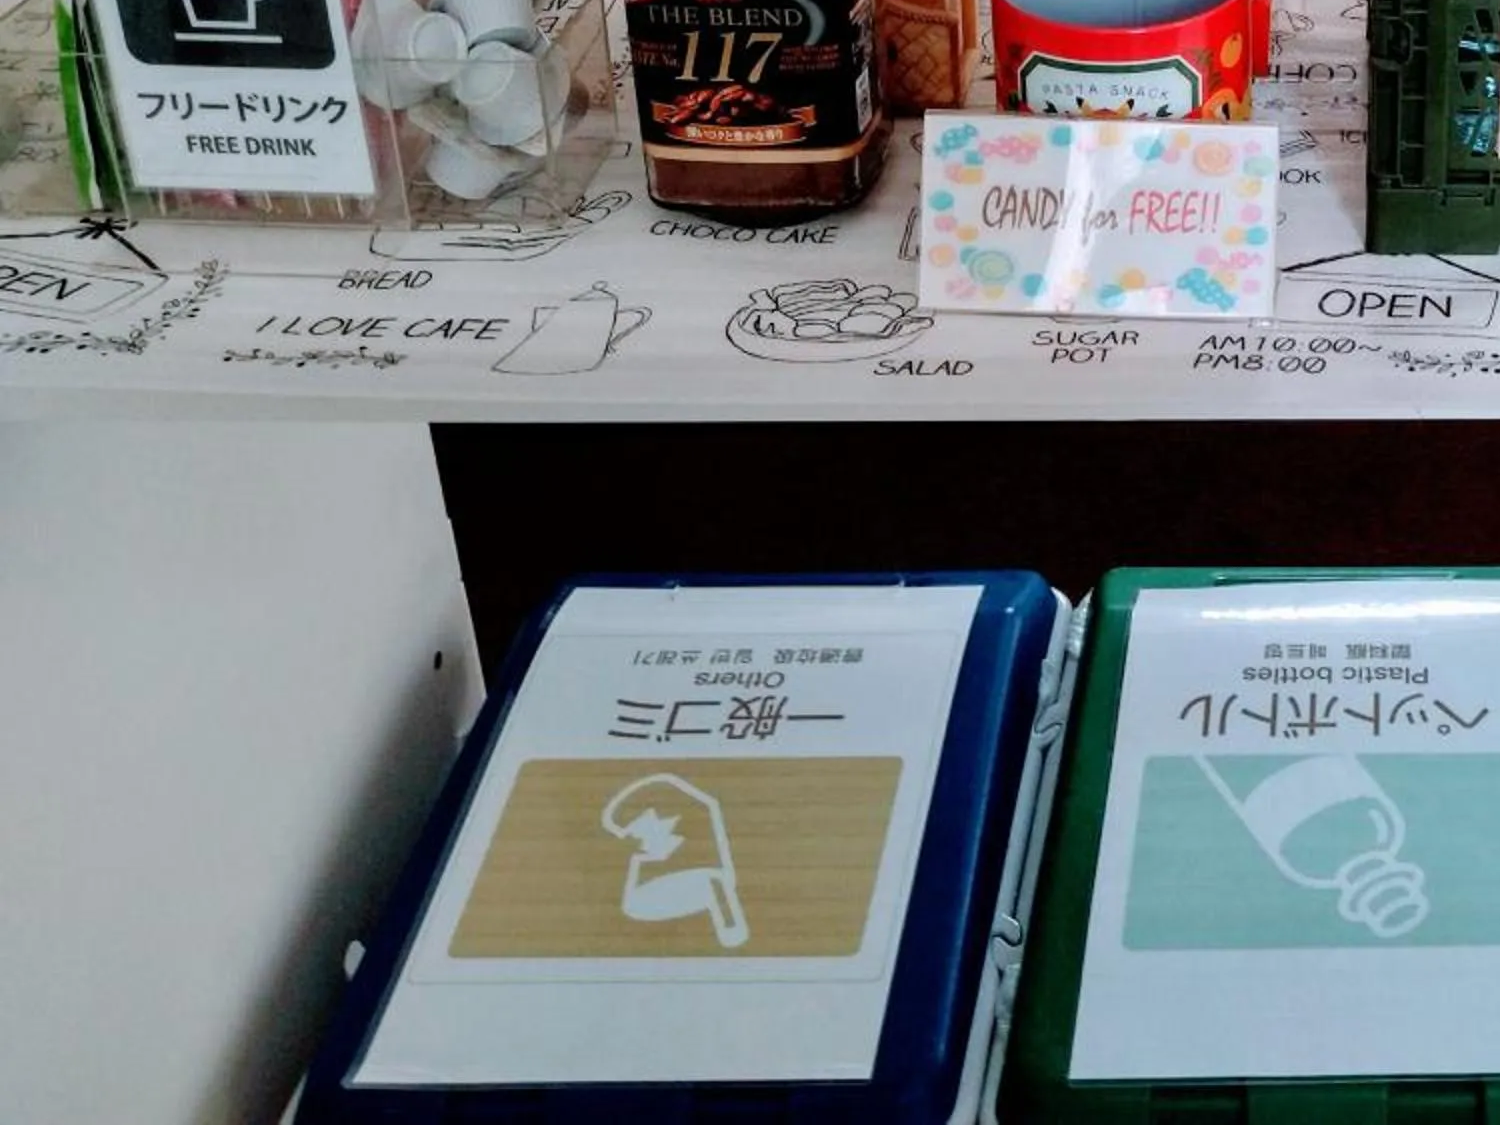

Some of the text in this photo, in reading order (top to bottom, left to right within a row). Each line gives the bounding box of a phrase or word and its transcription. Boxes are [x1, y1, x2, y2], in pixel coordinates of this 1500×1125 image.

[648, 6, 803, 27] THE BLEND
[674, 31, 784, 85] 117
[1042, 83, 1170, 100] PASTA SNACK
[137, 92, 348, 124] フリードリンク
[186, 135, 317, 156] FREE DRINK
[1081, 190, 1119, 248] for
[1129, 190, 1221, 236] FREE!!
[650, 220, 841, 244] CHOCO CAKE
[338, 270, 434, 290] BREAD
[1317, 288, 1452, 319] OPEN
[256, 316, 510, 340] I LOVE CAFE
[1031, 330, 1140, 347] SUGAR
[1050, 347, 1112, 364] POT
[1193, 353, 1328, 375] PM8:00
[873, 359, 975, 376] SALAD
[631, 649, 702, 666] 쓰레기
[709, 648, 753, 665] 일반
[693, 671, 786, 690] Others
[1242, 665, 1430, 685] Plastic bottles
[608, 696, 845, 743] 一般ゴミ
[1179, 691, 1489, 738] ペットボトル
